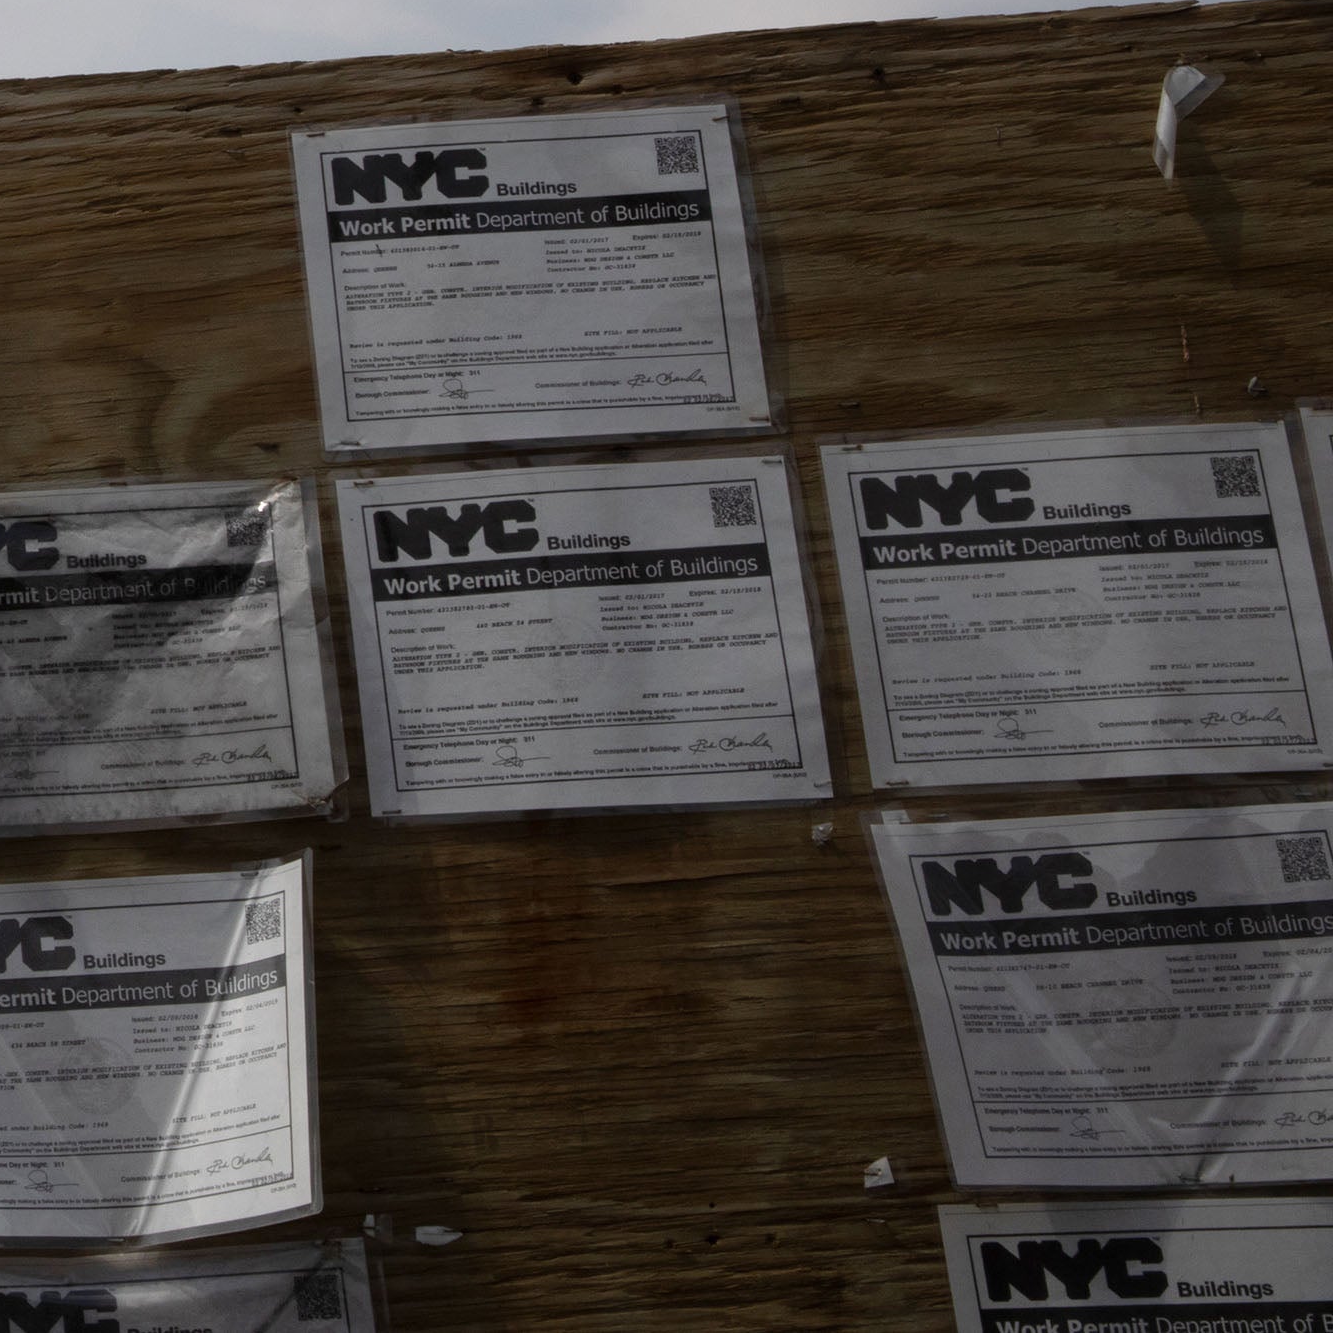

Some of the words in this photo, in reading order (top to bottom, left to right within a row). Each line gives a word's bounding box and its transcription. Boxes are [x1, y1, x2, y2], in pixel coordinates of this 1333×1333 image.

[859, 468, 1034, 529] NYC
[1043, 503, 1131, 519] Buildings
[373, 499, 539, 562] NYC
[547, 534, 630, 549] Buildings
[873, 544, 933, 562] Work
[940, 540, 1016, 558] Permit
[1022, 532, 1141, 556] Department
[1149, 529, 1166, 546] of
[1174, 527, 1263, 546] Buildings
[383, 575, 441, 594] Work
[448, 570, 521, 589] Permit
[526, 563, 639, 585] Department
[646, 560, 663, 577] of
[670, 557, 757, 575] Buildings
[441, 740, 474, 748] Telephone
[83, 953, 165, 968] Buildings
[63, 984, 173, 1007] Department
[180, 980, 197, 997] of
[206, 968, 277, 995] Buildings
